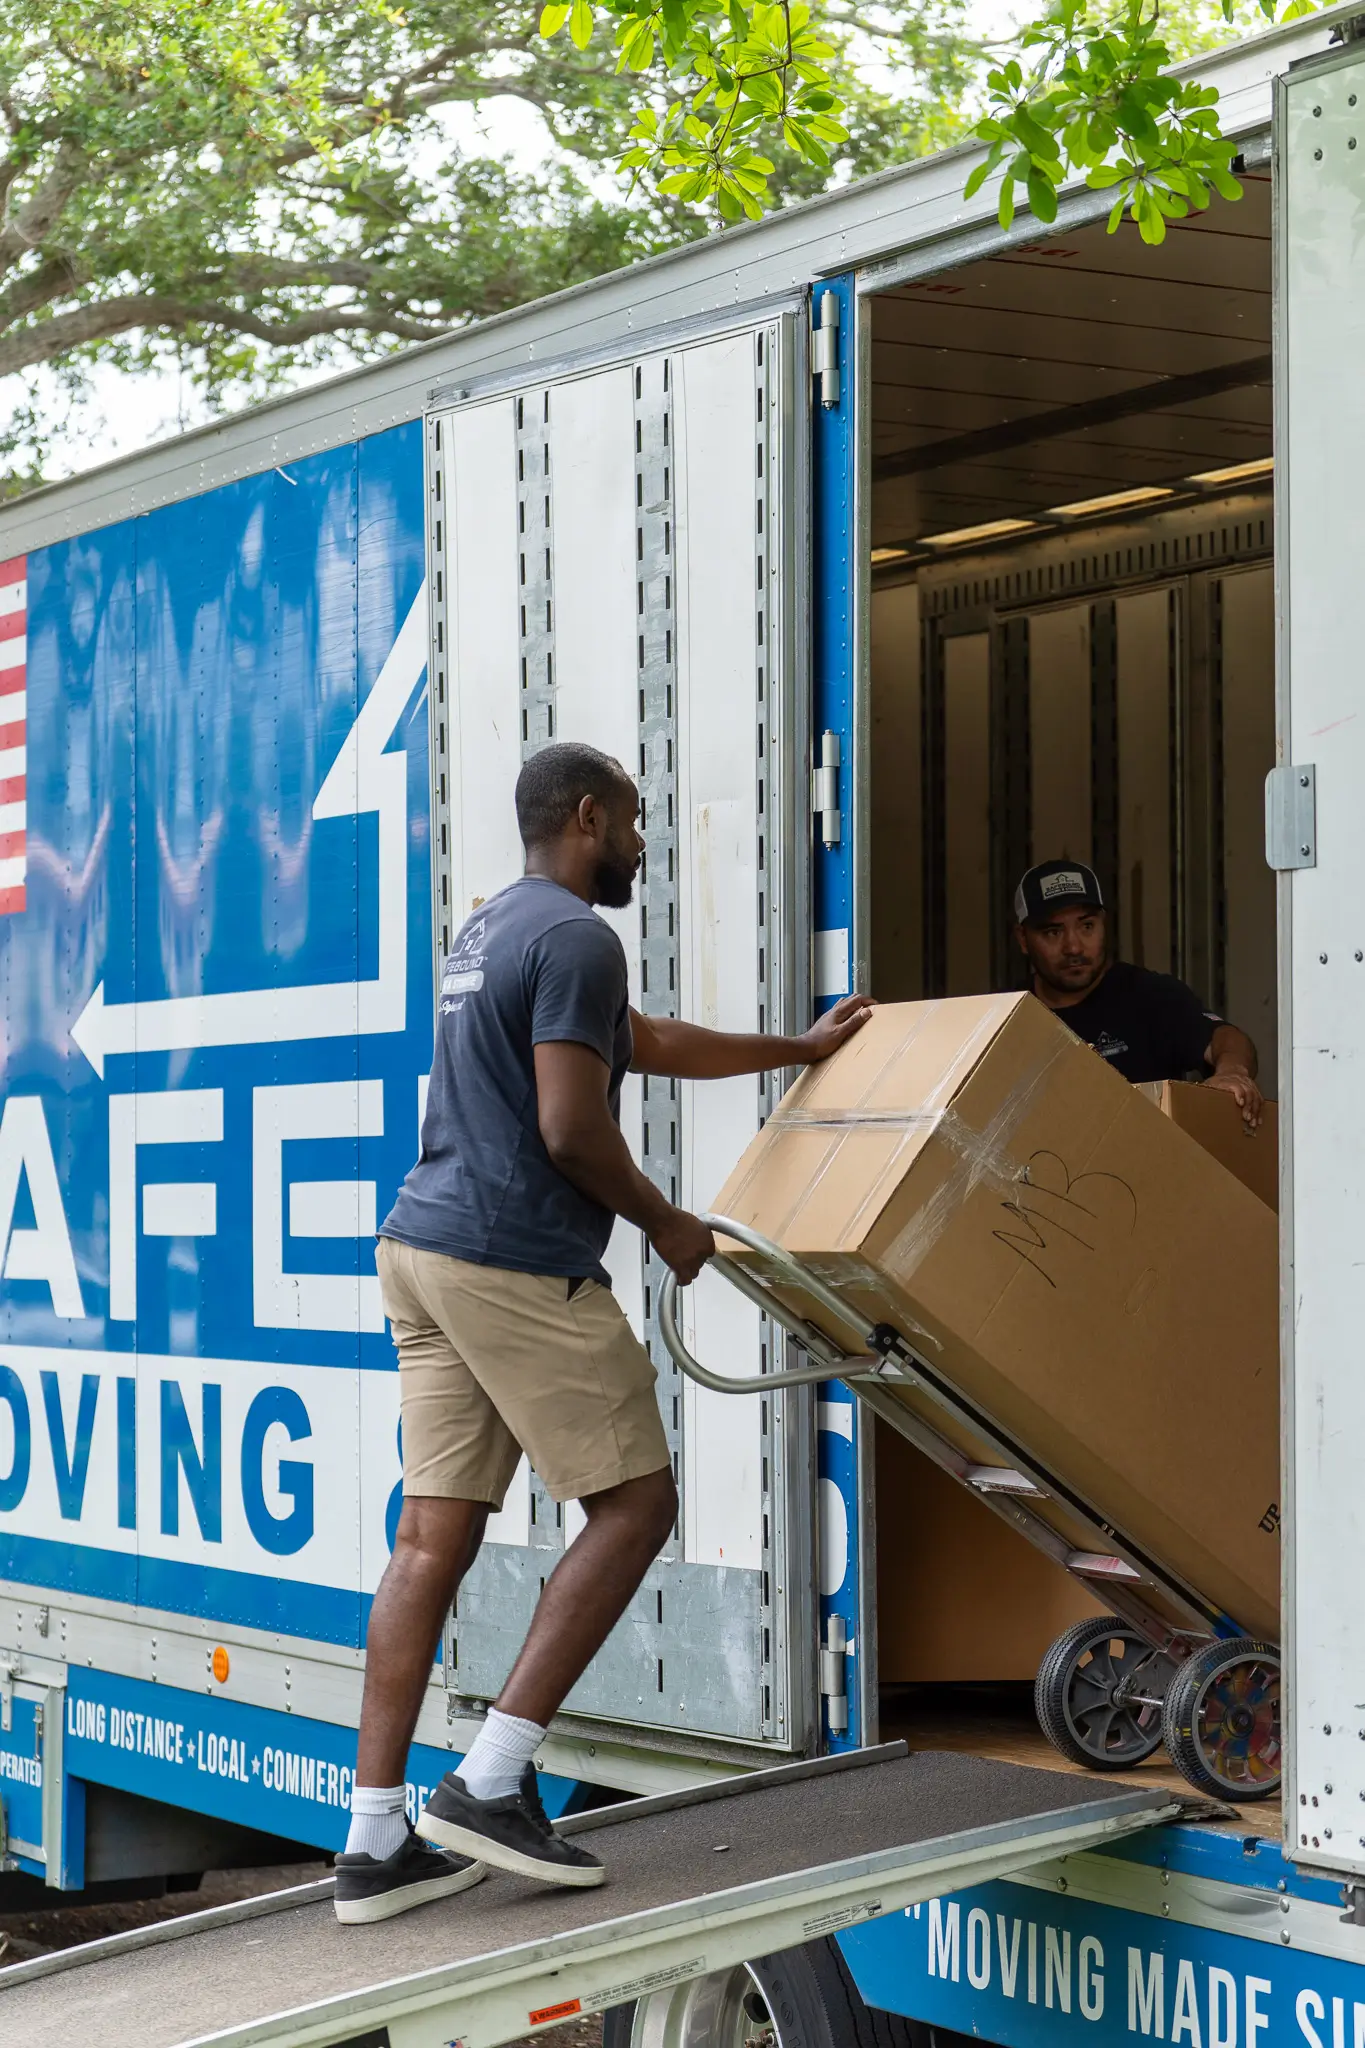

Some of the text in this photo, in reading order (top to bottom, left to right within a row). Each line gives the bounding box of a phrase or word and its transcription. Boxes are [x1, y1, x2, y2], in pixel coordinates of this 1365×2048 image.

[0, 1075, 430, 1333] AFE
[1258, 1503, 1280, 1533] UP
[0, 1750, 42, 1788] PERATED
[67, 1696, 106, 1744] LONG
[110, 1707, 184, 1764] DISTANCE
[198, 1730, 249, 1783] LOCAL
[1295, 1988, 1365, 2048] SI
